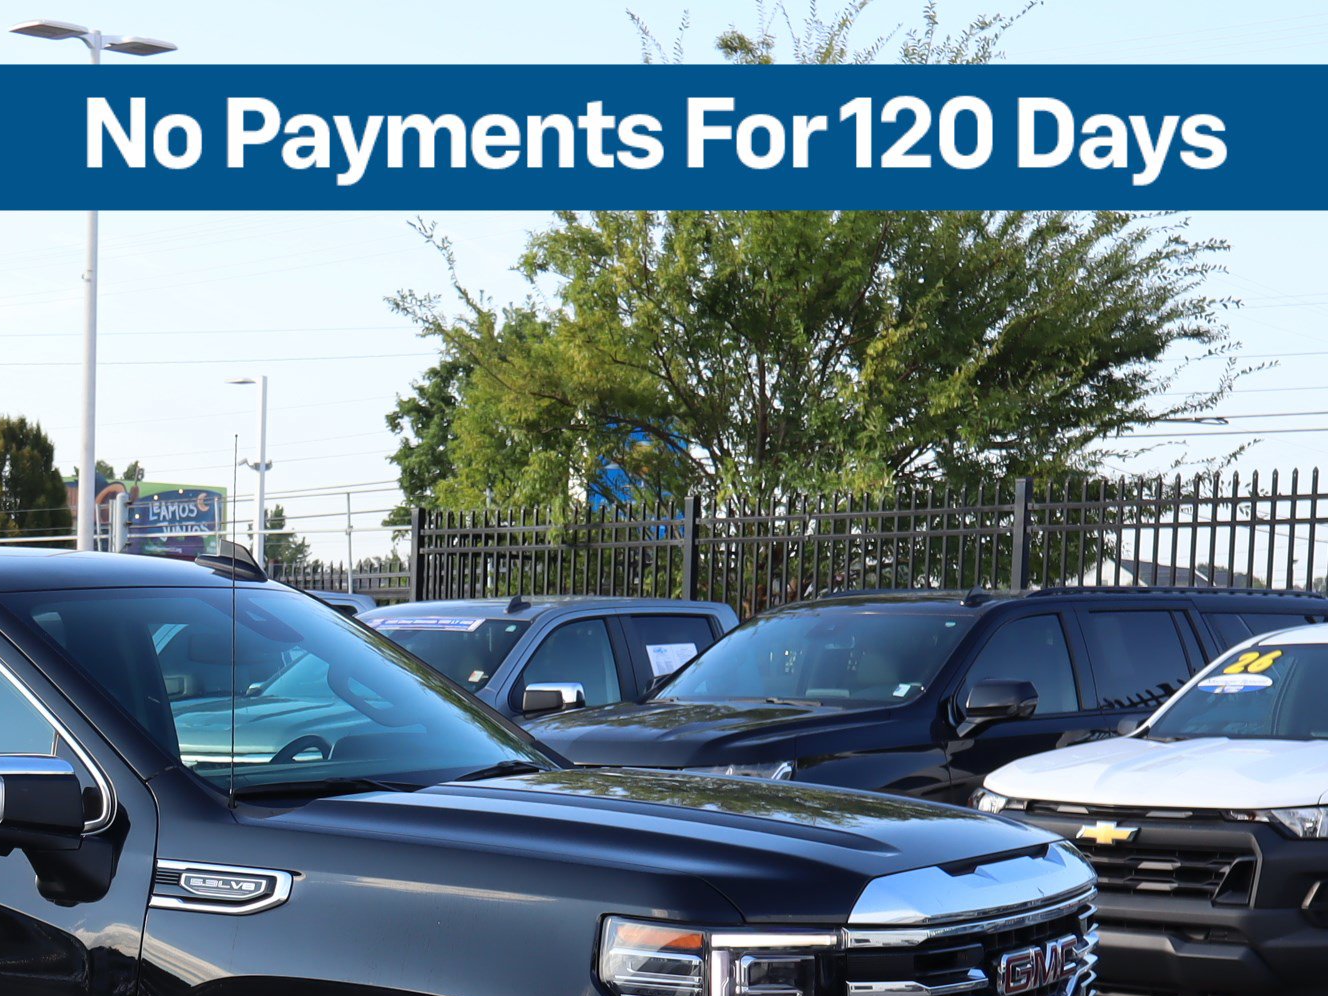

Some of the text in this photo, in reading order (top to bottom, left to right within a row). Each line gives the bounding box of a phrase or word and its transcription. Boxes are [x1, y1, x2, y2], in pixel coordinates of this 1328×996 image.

[149, 501, 198, 520] LEAMOS
[1223, 650, 1282, 674] 26
[998, 935, 1078, 996] GMC
